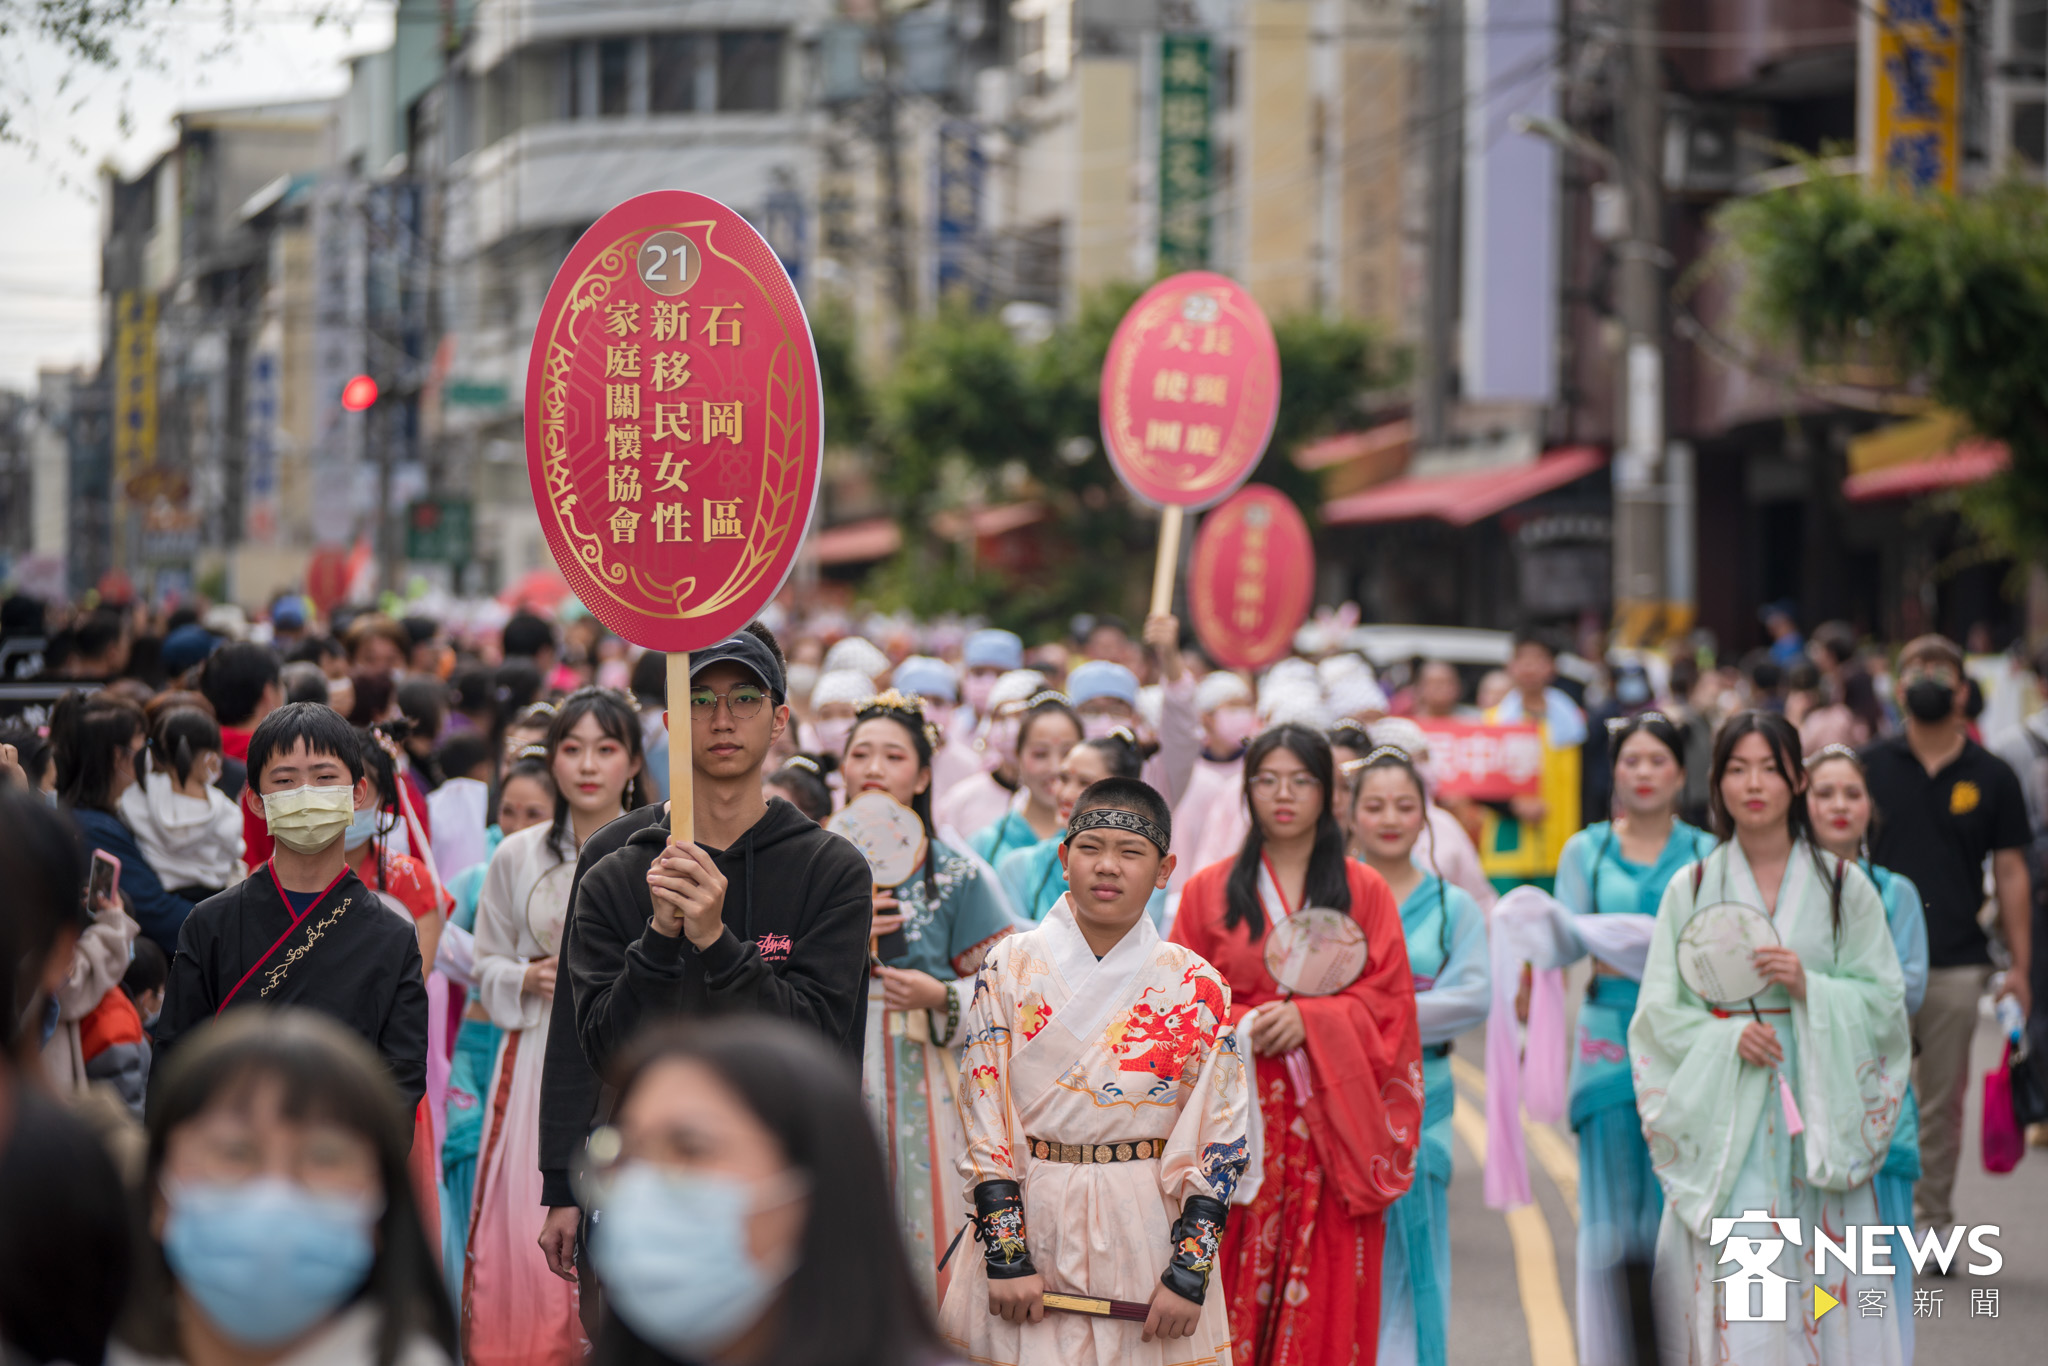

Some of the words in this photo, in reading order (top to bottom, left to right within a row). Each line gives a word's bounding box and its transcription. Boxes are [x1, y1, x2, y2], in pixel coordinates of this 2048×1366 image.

[644, 244, 689, 282] 21
[1183, 295, 1219, 322] 22
[604, 300, 642, 543] 家庭關懷協會
[650, 300, 693, 543] 新移民女性
[700, 301, 746, 543] 石岡區
